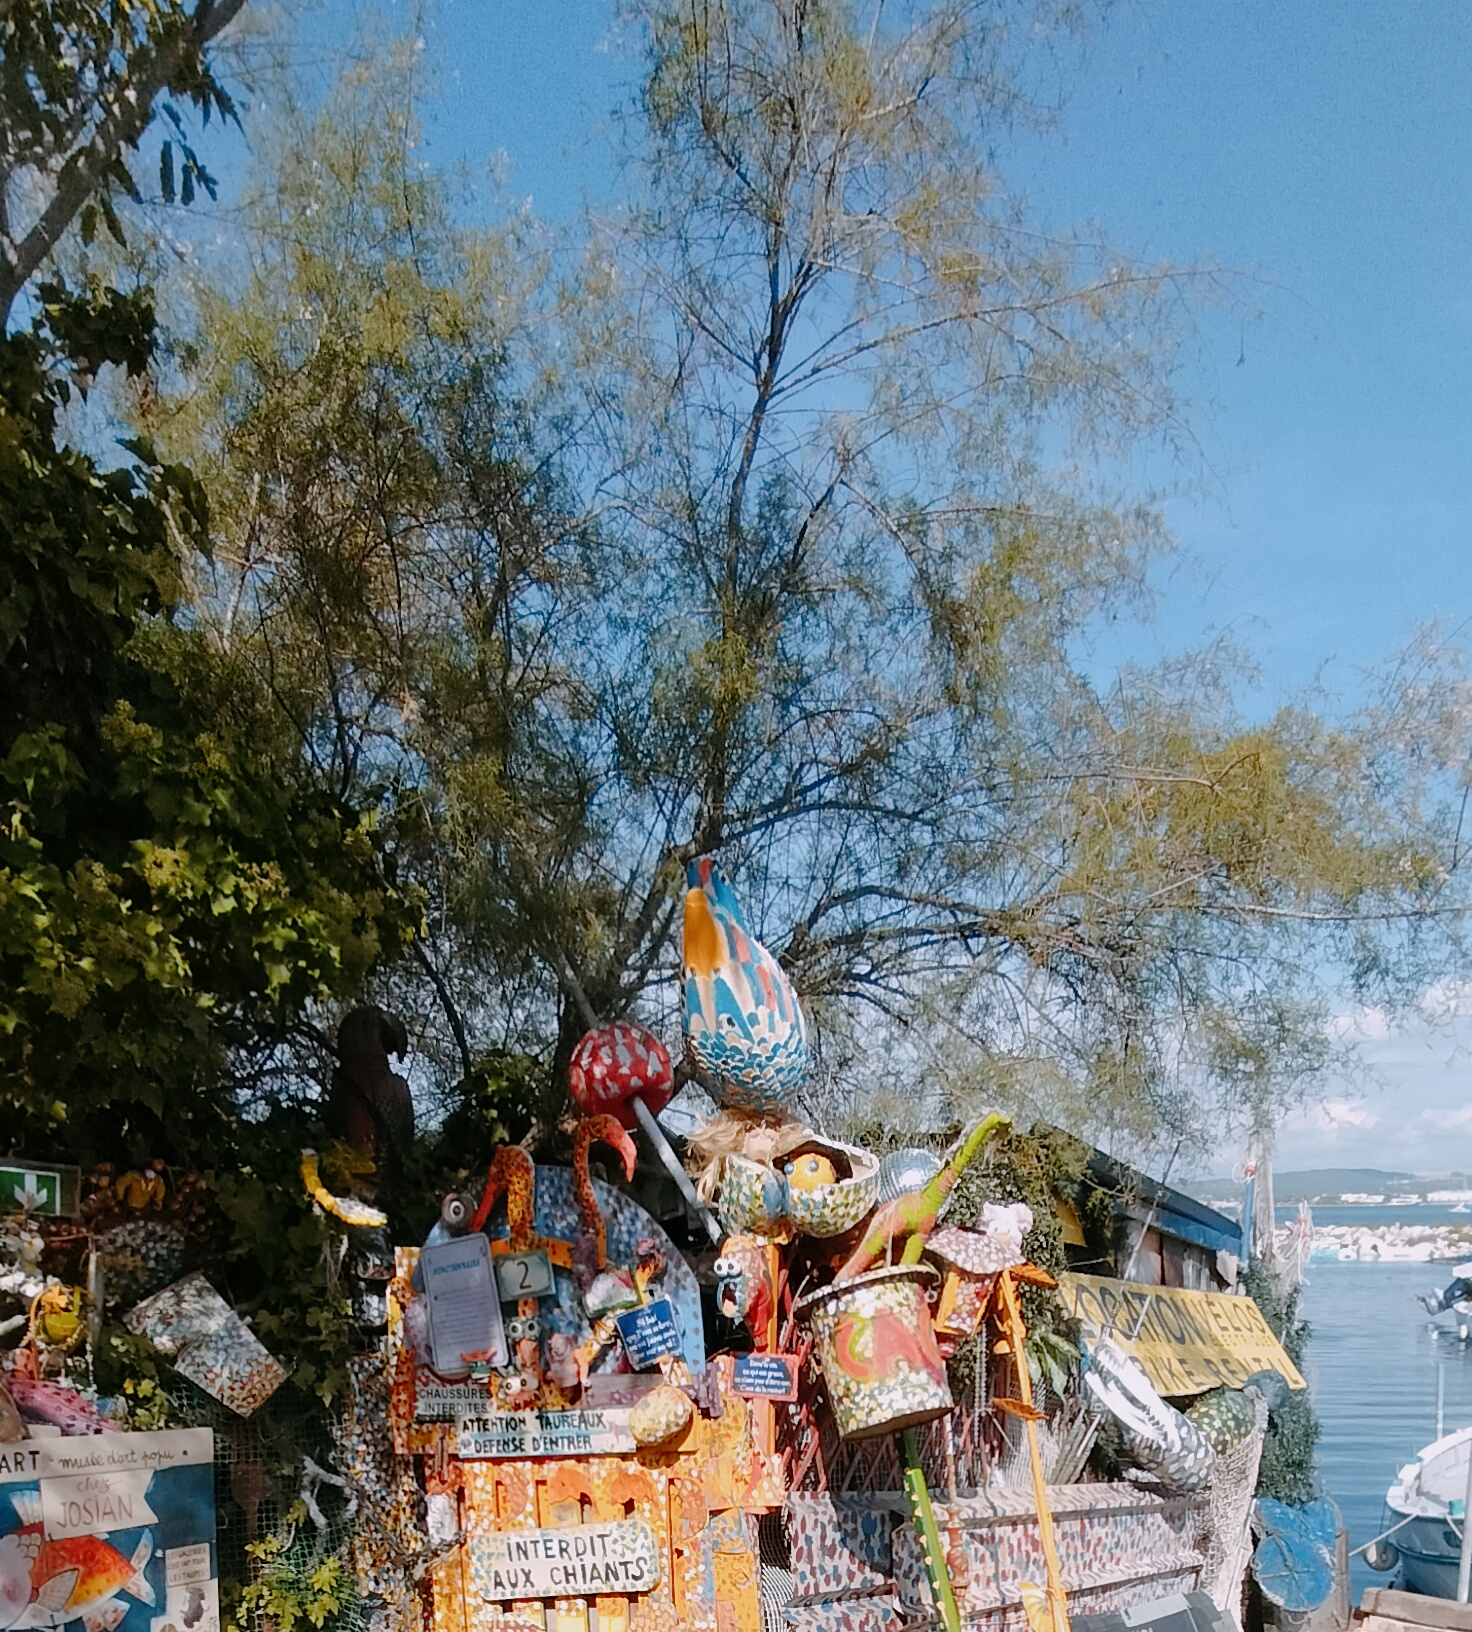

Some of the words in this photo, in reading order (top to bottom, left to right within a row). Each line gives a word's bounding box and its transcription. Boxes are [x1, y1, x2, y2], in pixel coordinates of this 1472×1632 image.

[517, 1260, 532, 1290] 2
[1190, 1293, 1266, 1334] VÉLOS
[419, 1387, 492, 1400] CHAUSSURES
[424, 1402, 488, 1415] INTERDITES
[462, 1416, 527, 1434] ATTENTION
[537, 1411, 607, 1432] TAUREAUX
[474, 1437, 526, 1454] DEFENSE
[532, 1434, 593, 1451] D'ENTRER
[0, 1450, 40, 1474] ART
[141, 1450, 175, 1468] popu
[506, 1529, 613, 1562] INTERDIT
[494, 1567, 534, 1590] AUX
[550, 1556, 648, 1585] CHIANTS
